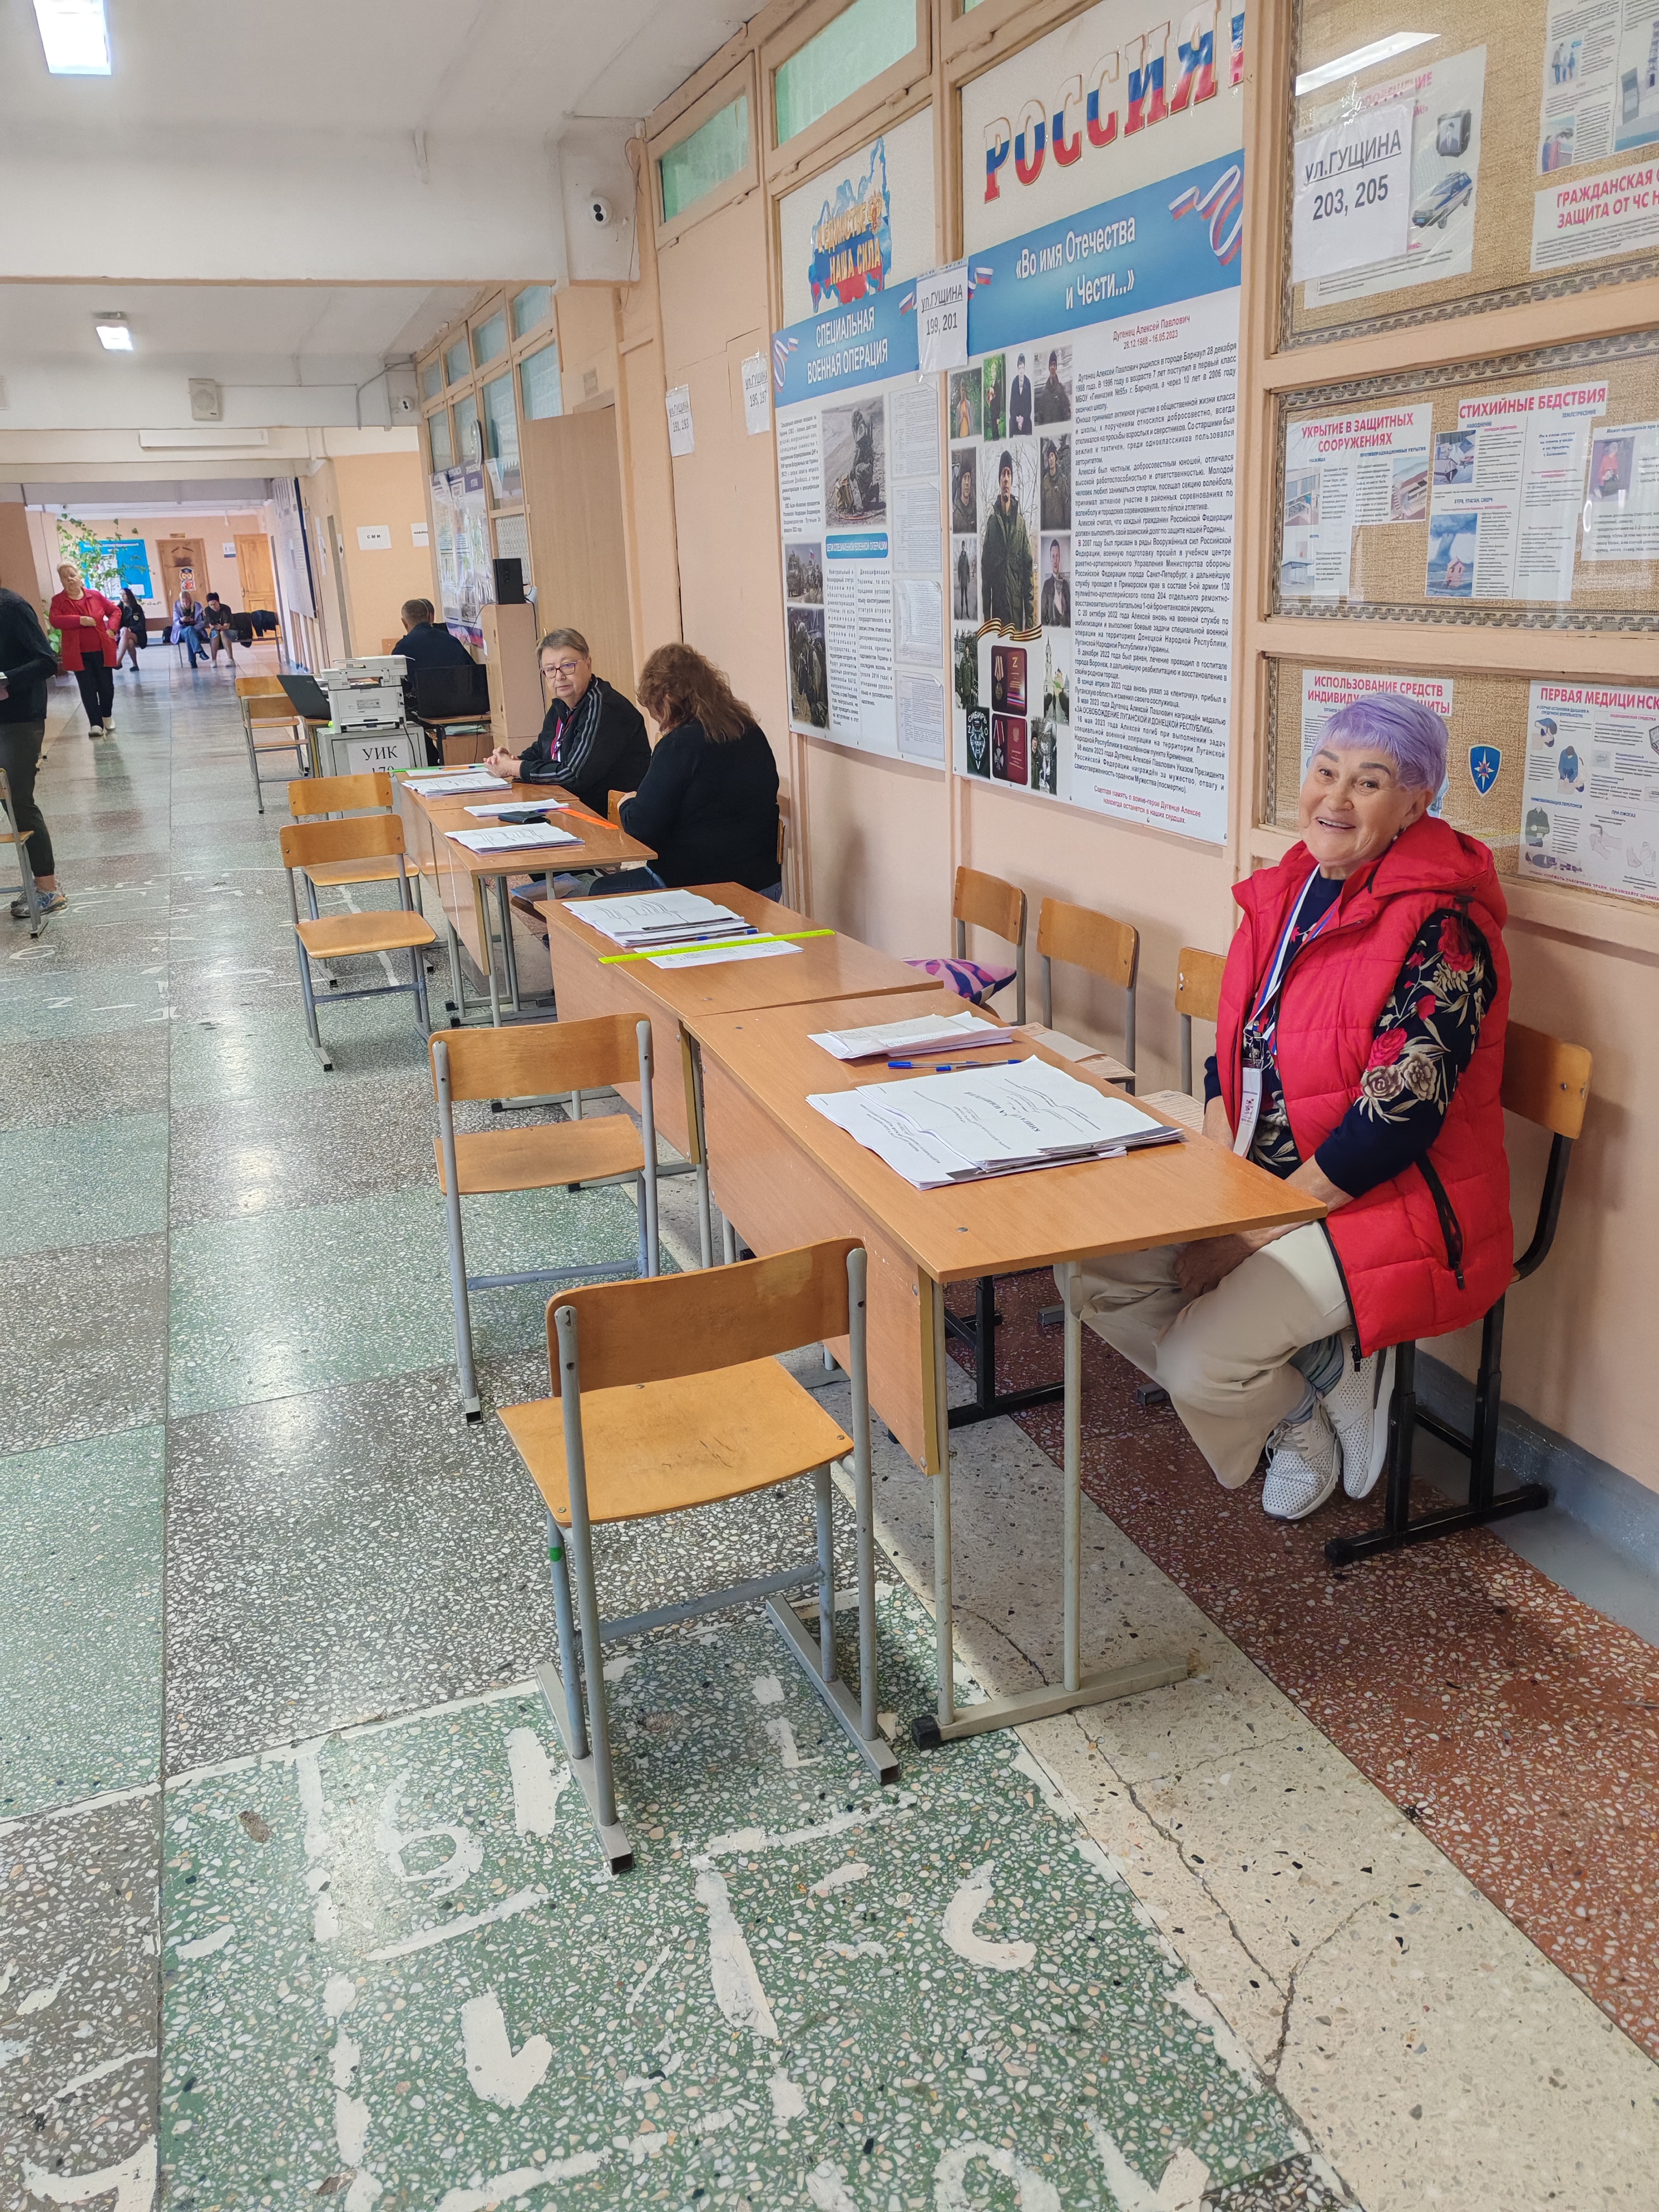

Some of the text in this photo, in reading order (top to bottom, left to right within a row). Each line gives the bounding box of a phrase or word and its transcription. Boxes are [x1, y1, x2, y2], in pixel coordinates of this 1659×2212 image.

[983, 0, 1222, 204] РОССИЯ
[1313, 174, 1388, 220] 203, 205
[1557, 169, 1653, 208] ГРАЖДАНСКАЯ
[1557, 202, 1609, 228] ЗАЩИТА
[1613, 197, 1630, 214] ОТ
[1633, 192, 1649, 209] ЧС
[1016, 217, 1135, 279] «Во имя Отечества
[1066, 269, 1135, 310] и Чести...»
[816, 306, 874, 348] СПЕЦИАЛЬНАЯ
[927, 312, 957, 336] 199, 201
[1161, 313, 1190, 329] Павлович
[807, 338, 888, 385] ВОЕННАЯ ОПЕРАЦИЯ
[1183, 349, 1206, 360] Барнаул
[1206, 346, 1213, 355] 28
[1459, 388, 1606, 419] СТИХИЙНЫЕ БЕДСТВИЯ
[1195, 429, 1235, 441] пользовался
[1301, 413, 1414, 439] УКРЫТИЕ В ЗАЩИТНЫХ
[1318, 433, 1393, 453] СООРУЖЕНИЯХ
[1202, 512, 1232, 522] Федерации
[1157, 591, 1166, 599] 204
[1314, 676, 1443, 697] ИСПОЛЬЗОВАНИЕ СРЕДСТВ
[1541, 687, 1582, 704] ПЕРВАЯ
[362, 746, 398, 761] УИК
